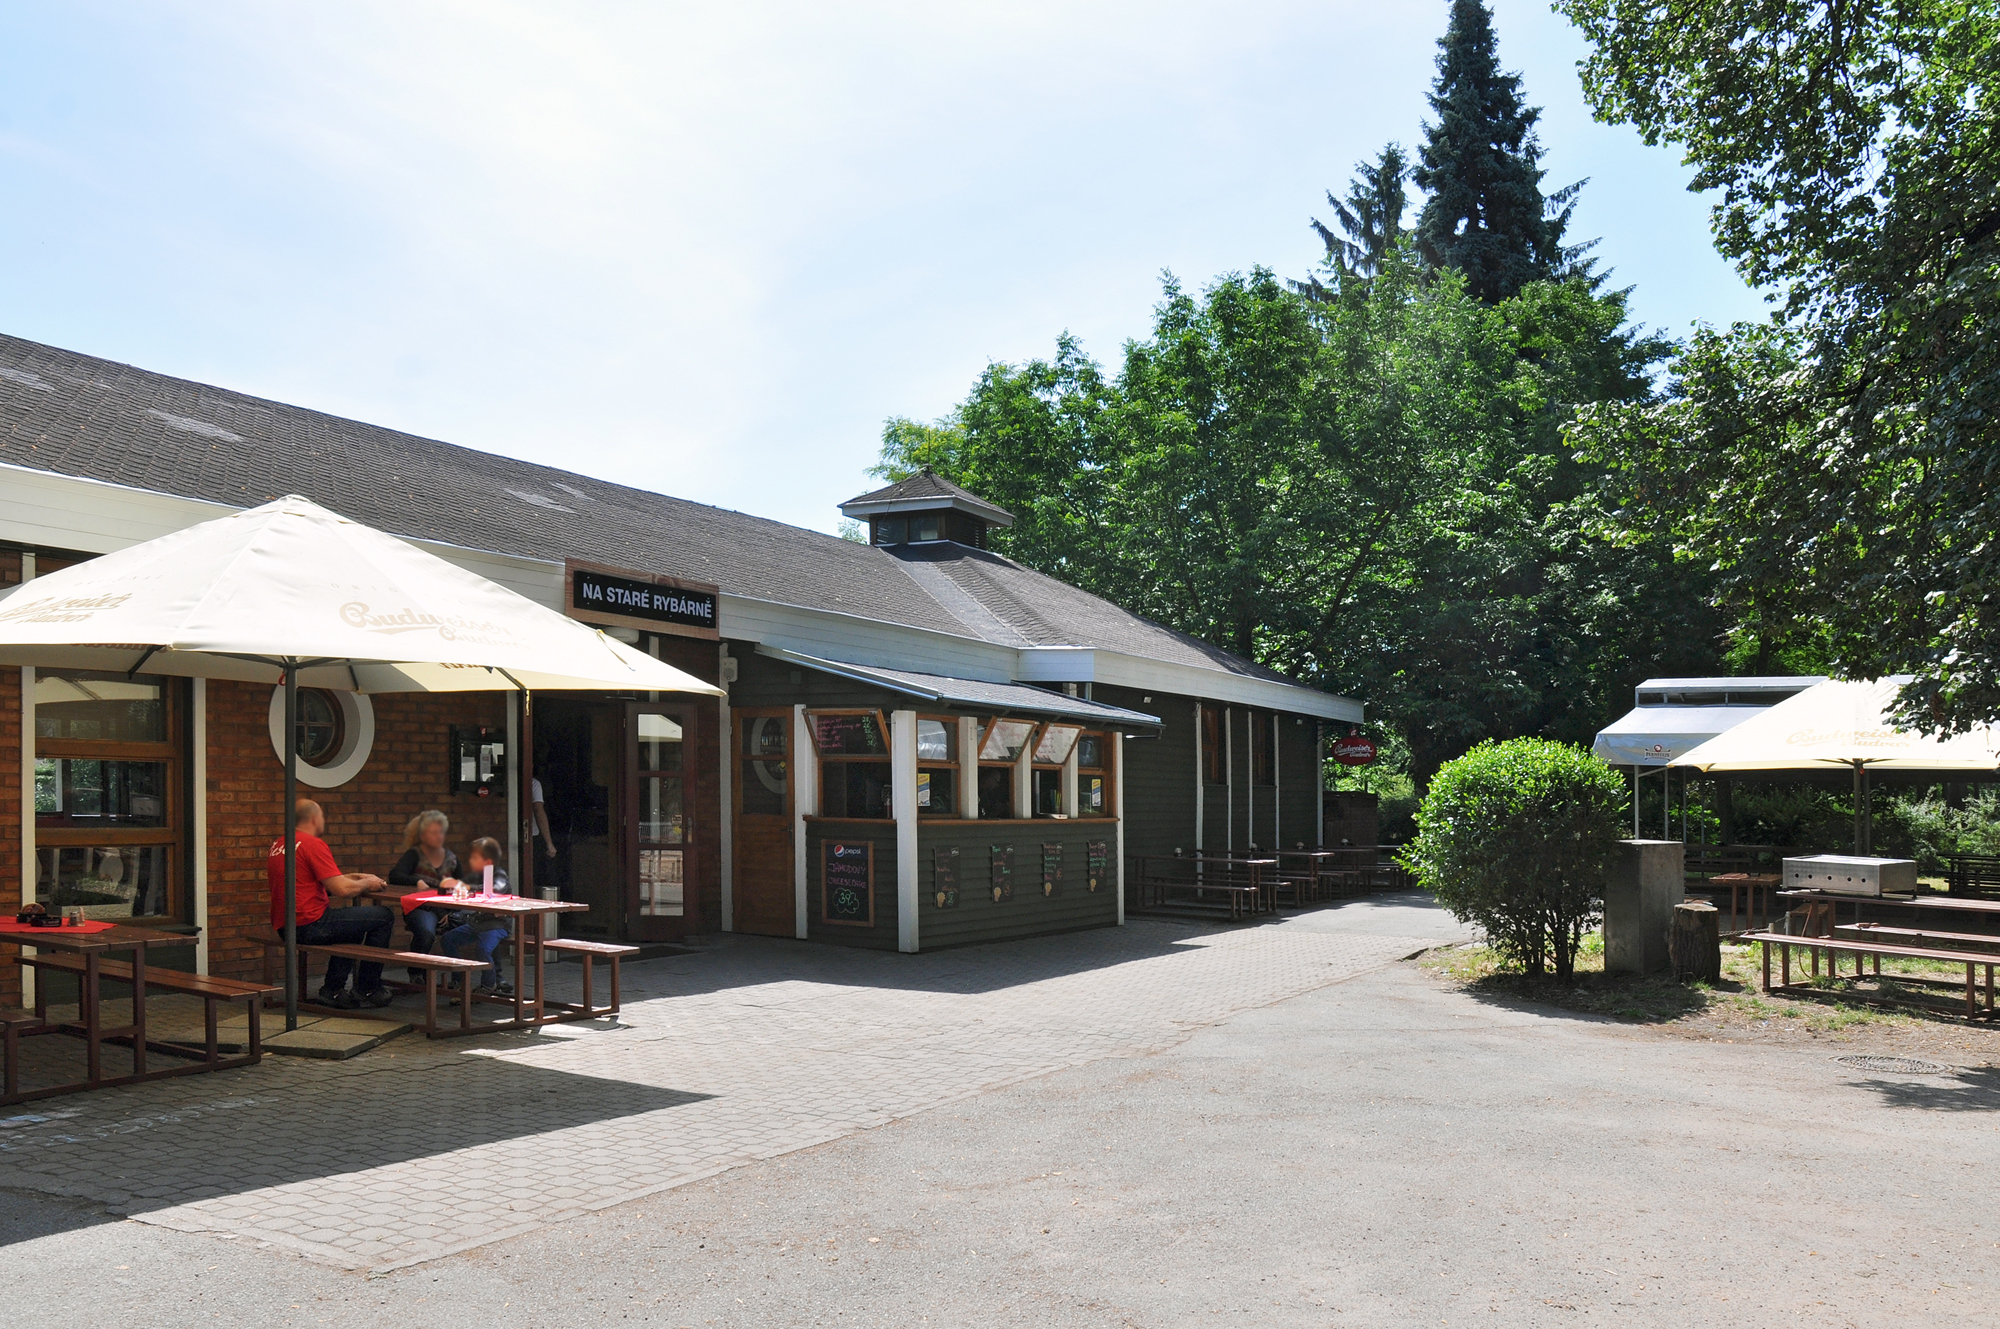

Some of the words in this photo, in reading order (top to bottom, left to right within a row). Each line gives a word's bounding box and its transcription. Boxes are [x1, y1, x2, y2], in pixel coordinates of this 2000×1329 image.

[582, 582, 603, 601] NA
[606, 587, 650, 608] STARÉ
[653, 595, 712, 618] RYBÁRNĚ
[339, 601, 512, 636] Budweiser
[1786, 729, 1913, 746] Budweiser
[1841, 737, 1910, 747] Budvar
[1334, 743, 1373, 756] Budweiser
